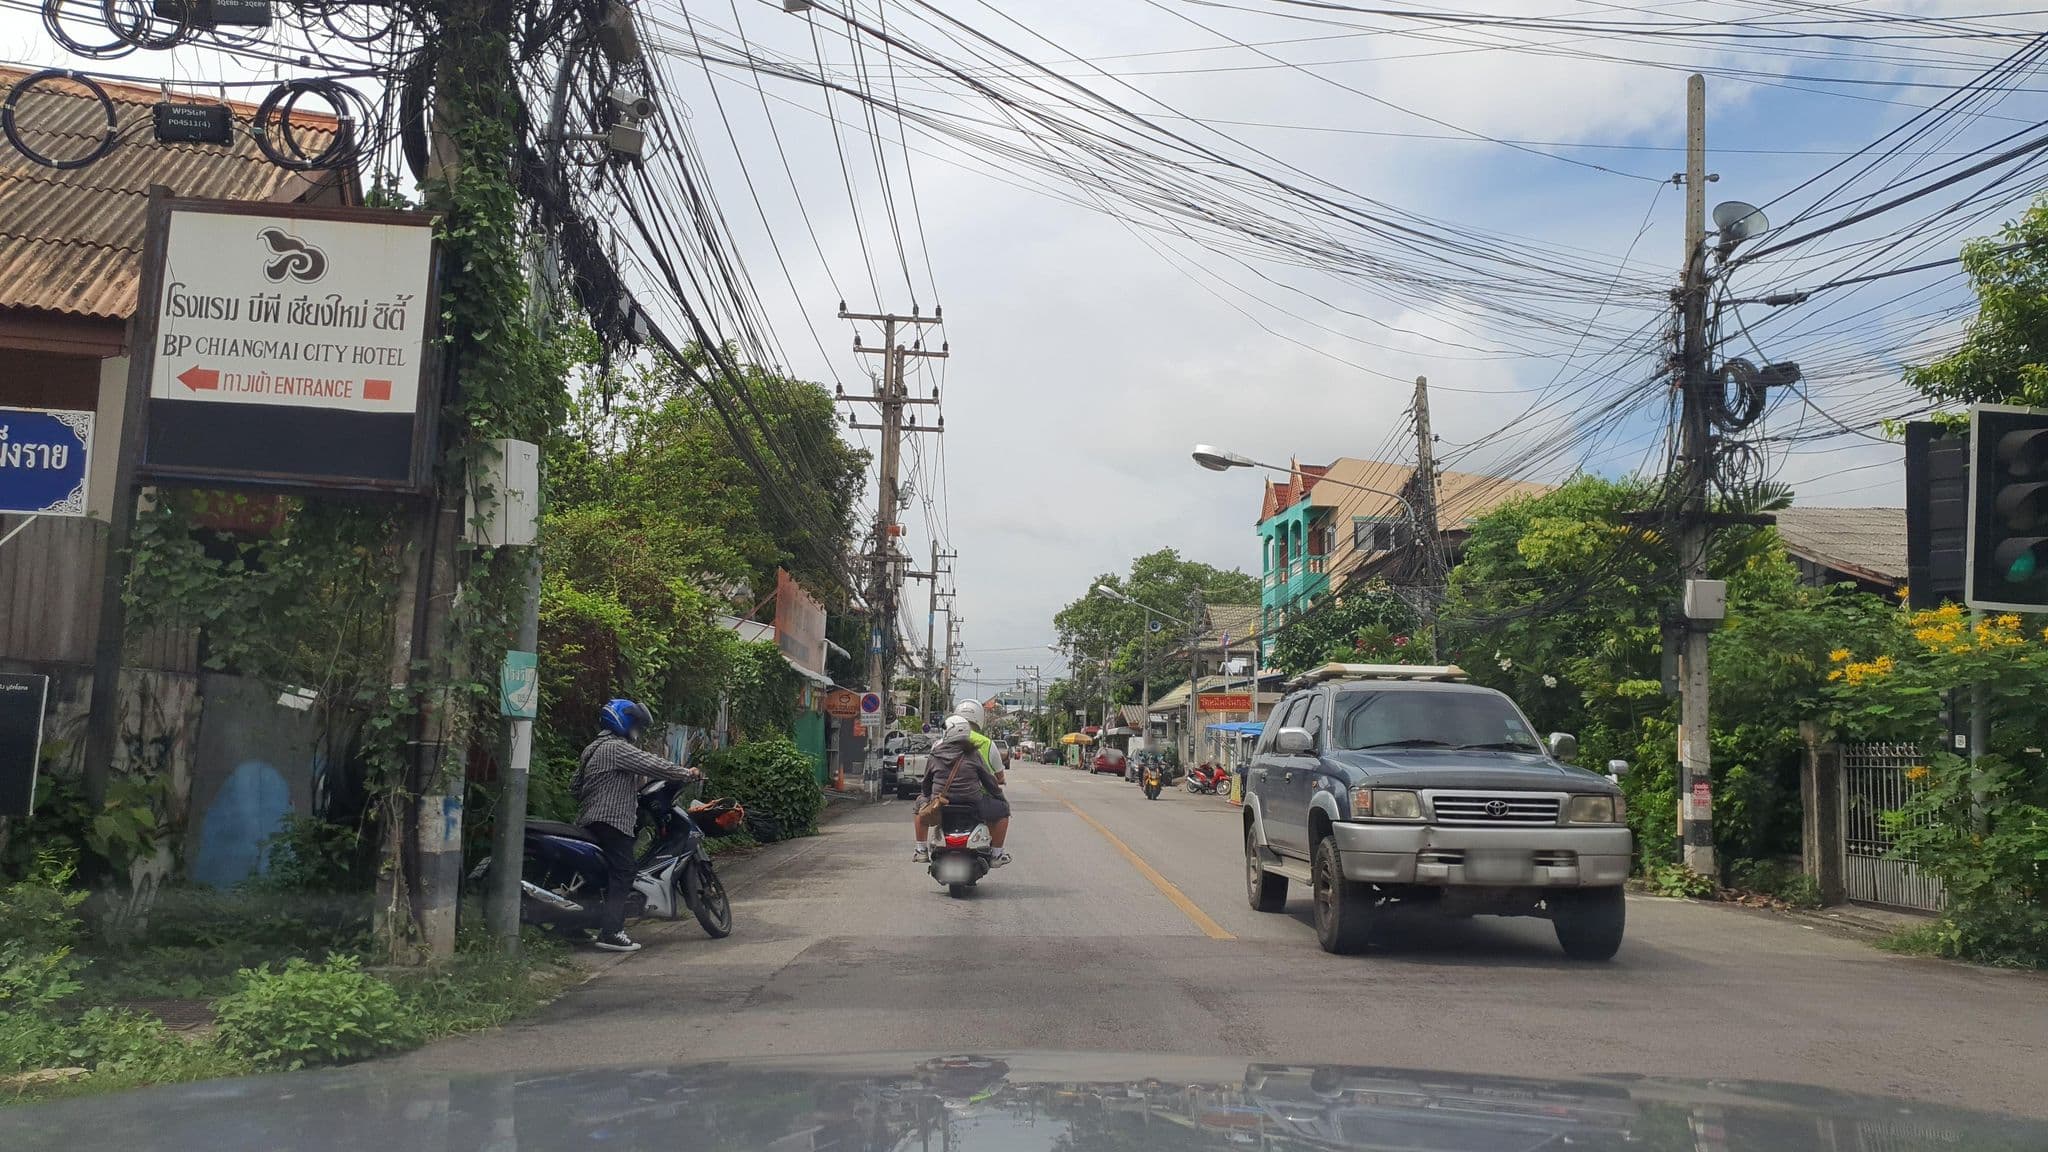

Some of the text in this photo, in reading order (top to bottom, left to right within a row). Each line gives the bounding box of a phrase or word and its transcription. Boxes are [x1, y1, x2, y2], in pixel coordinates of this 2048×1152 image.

[165, 282, 414, 332] โรงแรม บีพี เชียงใหม่ ซิตี้
[162, 334, 406, 367] BP CHIANGMAI CITY HOTEL
[223, 370, 353, 398] ทางเข้า ENTRANCE
